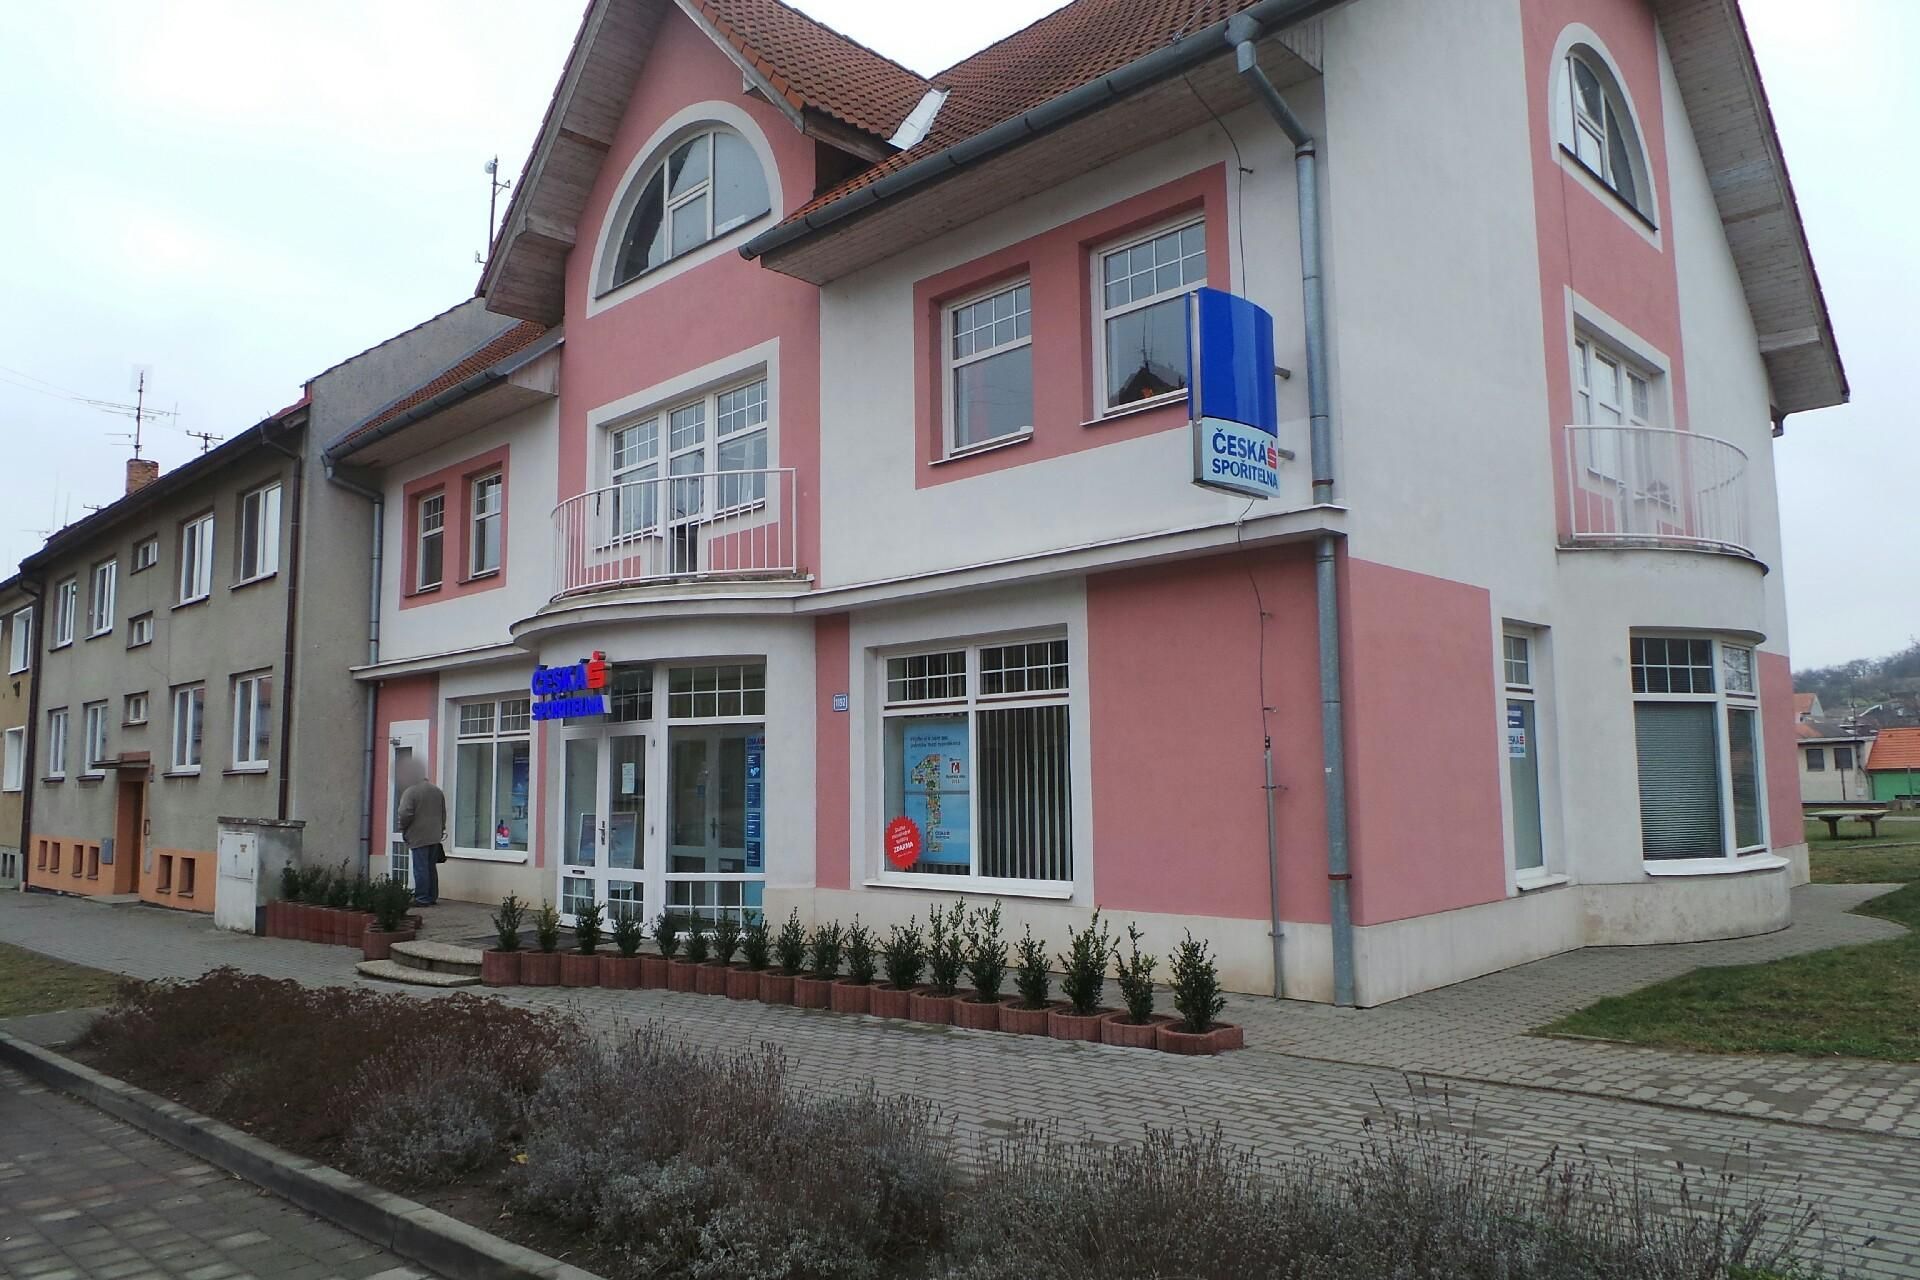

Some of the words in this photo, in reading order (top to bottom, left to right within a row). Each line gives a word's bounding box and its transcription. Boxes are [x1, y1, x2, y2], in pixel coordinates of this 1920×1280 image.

[1212, 427, 1267, 466] ČESKÁ
[1212, 458, 1279, 489] SPOŘITELNA
[532, 658, 588, 695] ČESKÁ
